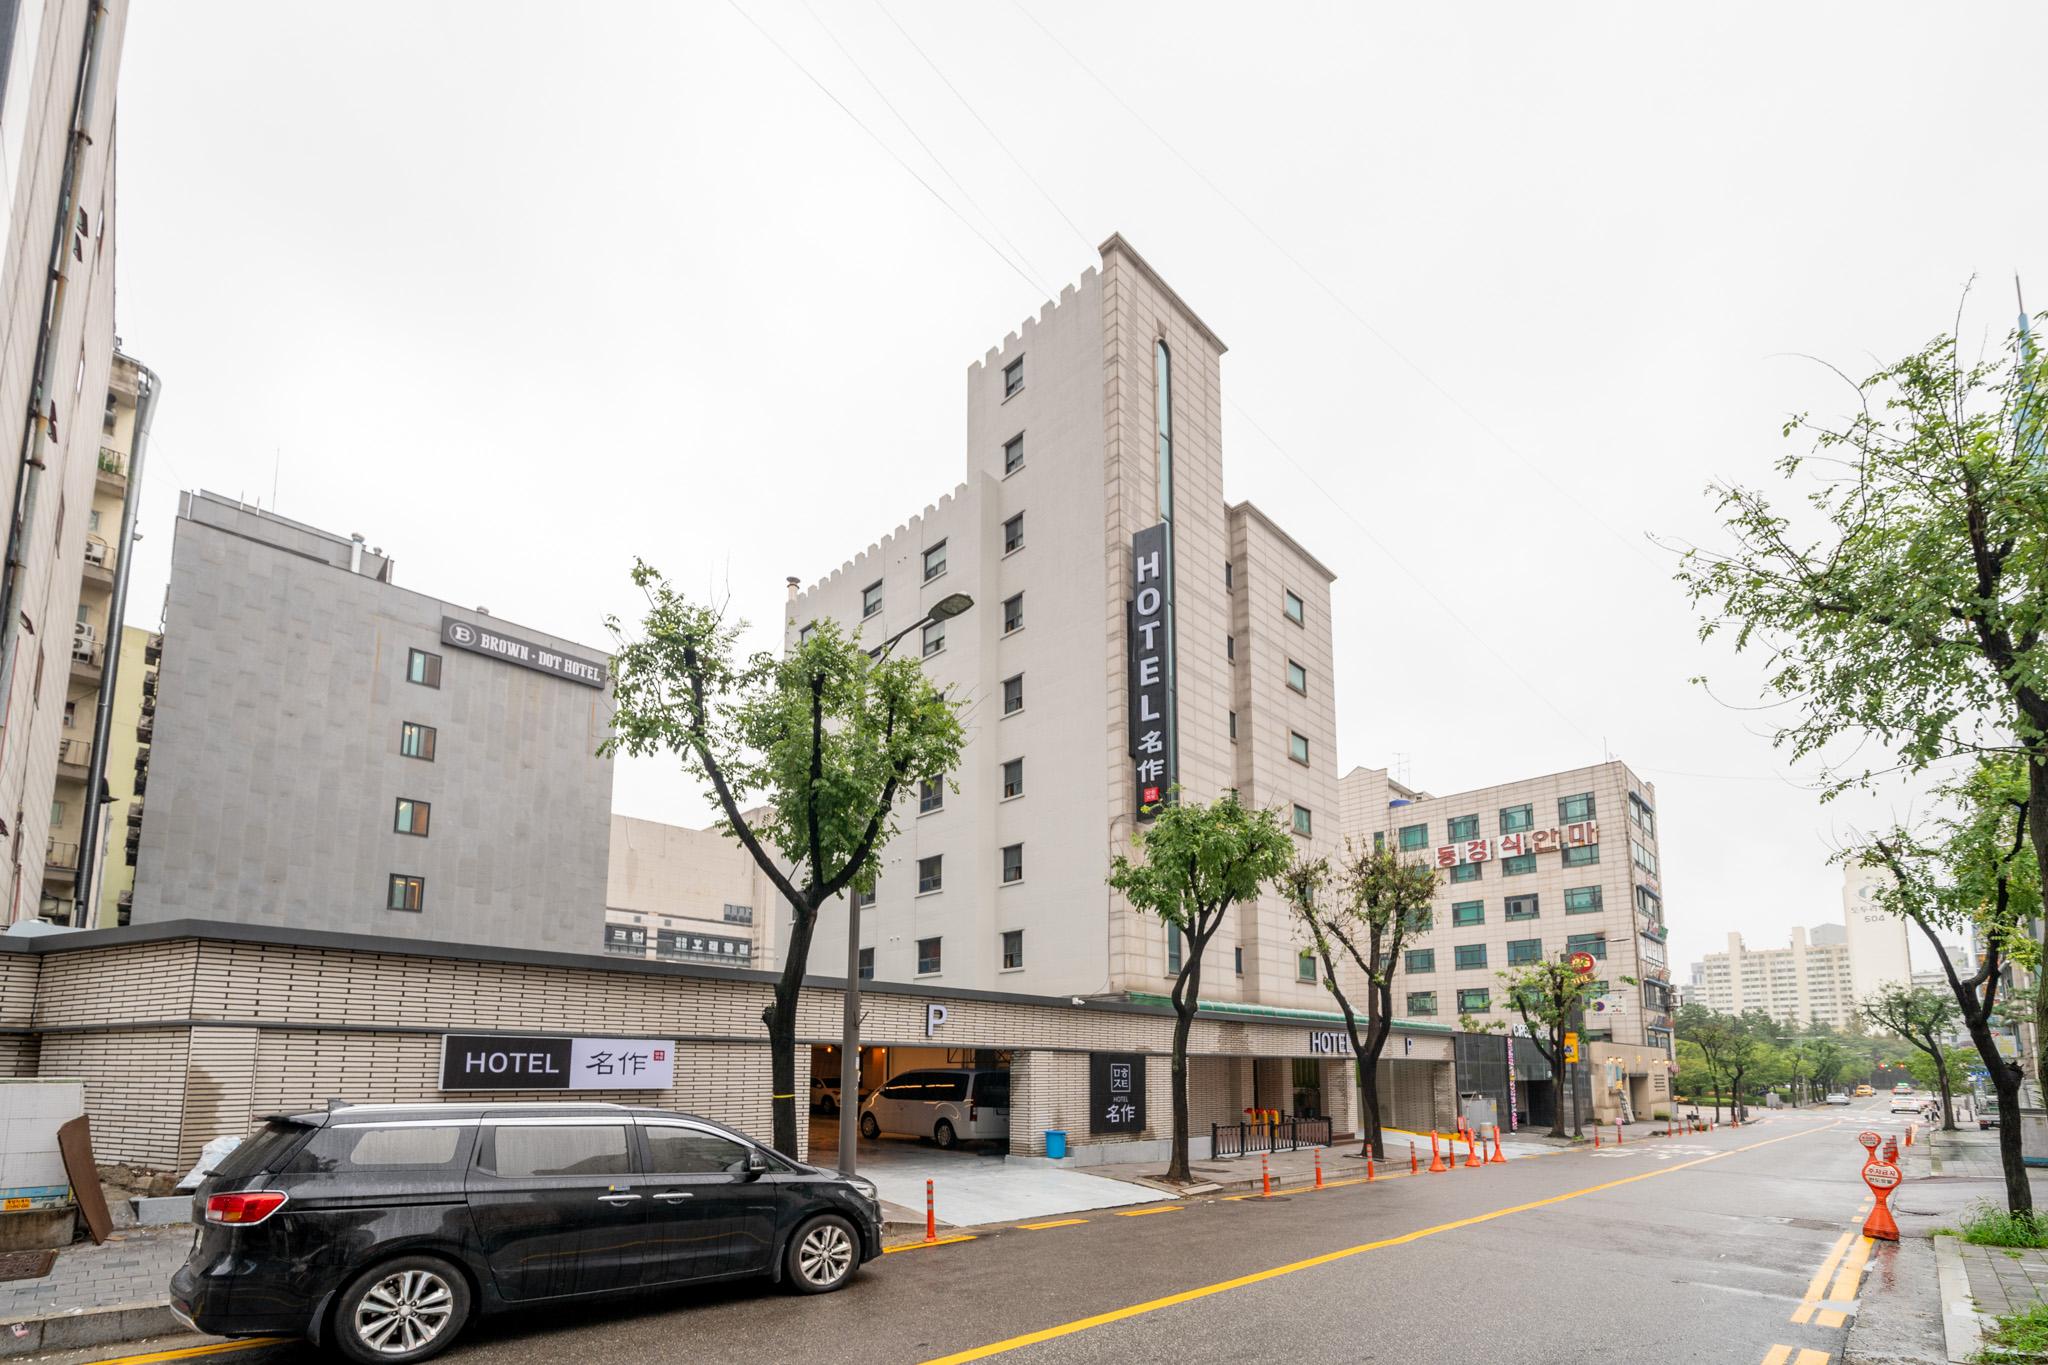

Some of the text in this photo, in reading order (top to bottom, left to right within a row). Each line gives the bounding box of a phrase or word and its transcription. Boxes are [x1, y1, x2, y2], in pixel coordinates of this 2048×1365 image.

[1136, 551, 1161, 722] HOTEL
[480, 633, 529, 660] BROWN
[538, 651, 562, 670] DOT
[564, 659, 601, 682] HOTEL
[1136, 730, 1165, 782] 名作
[926, 1004, 948, 1037] P
[465, 1052, 559, 1074] HOTEL
[585, 1050, 649, 1076] 名作
[1405, 1037, 1413, 1056] P
[1105, 1104, 1135, 1123] 名作
